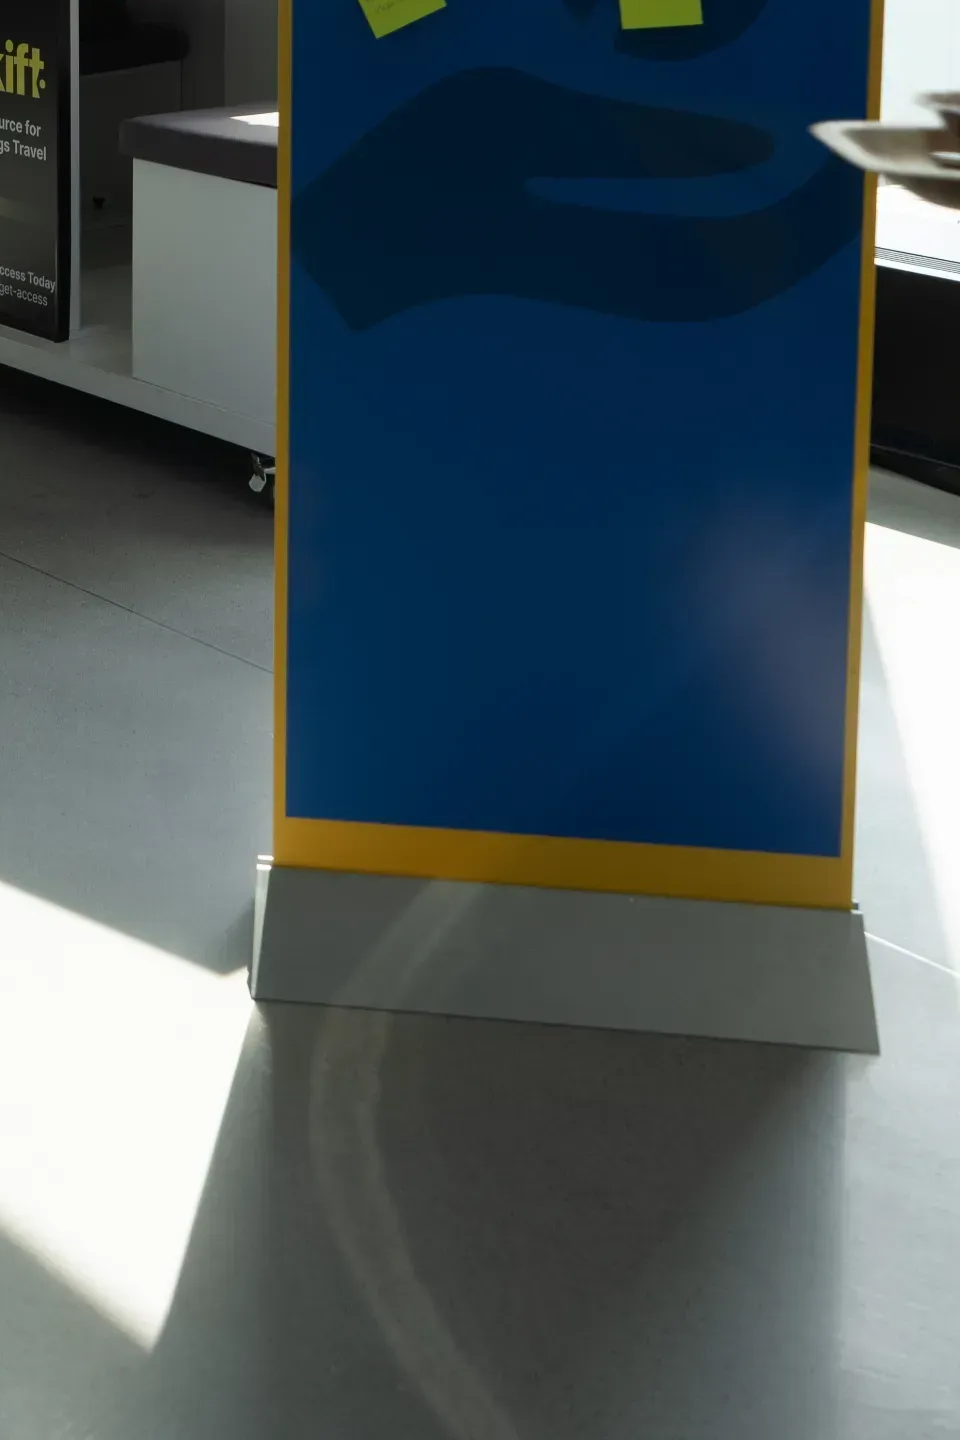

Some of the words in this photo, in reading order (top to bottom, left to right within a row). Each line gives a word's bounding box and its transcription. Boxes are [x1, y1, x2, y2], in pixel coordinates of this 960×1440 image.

[24, 120, 42, 137] for
[12, 139, 47, 161] Travel
[27, 271, 56, 294] Today
